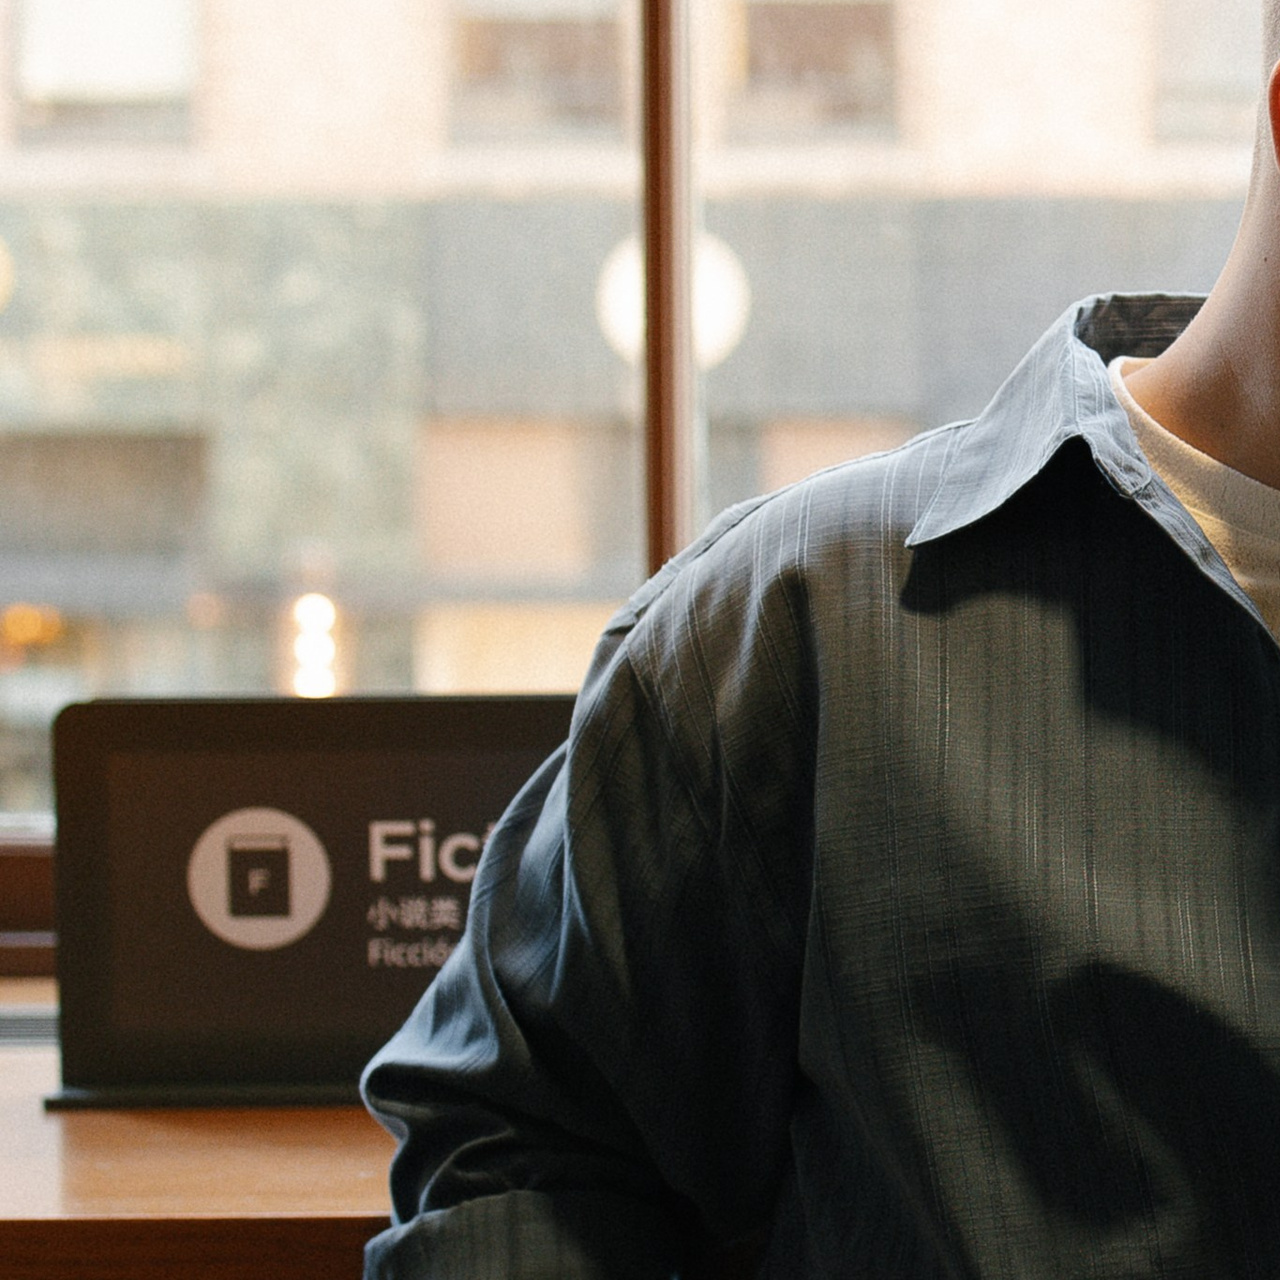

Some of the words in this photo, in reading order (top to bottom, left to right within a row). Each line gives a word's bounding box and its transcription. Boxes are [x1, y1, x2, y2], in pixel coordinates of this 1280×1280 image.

[369, 819, 493, 883] Fic
[248, 869, 271, 897] F
[367, 936, 457, 968] Ficció
